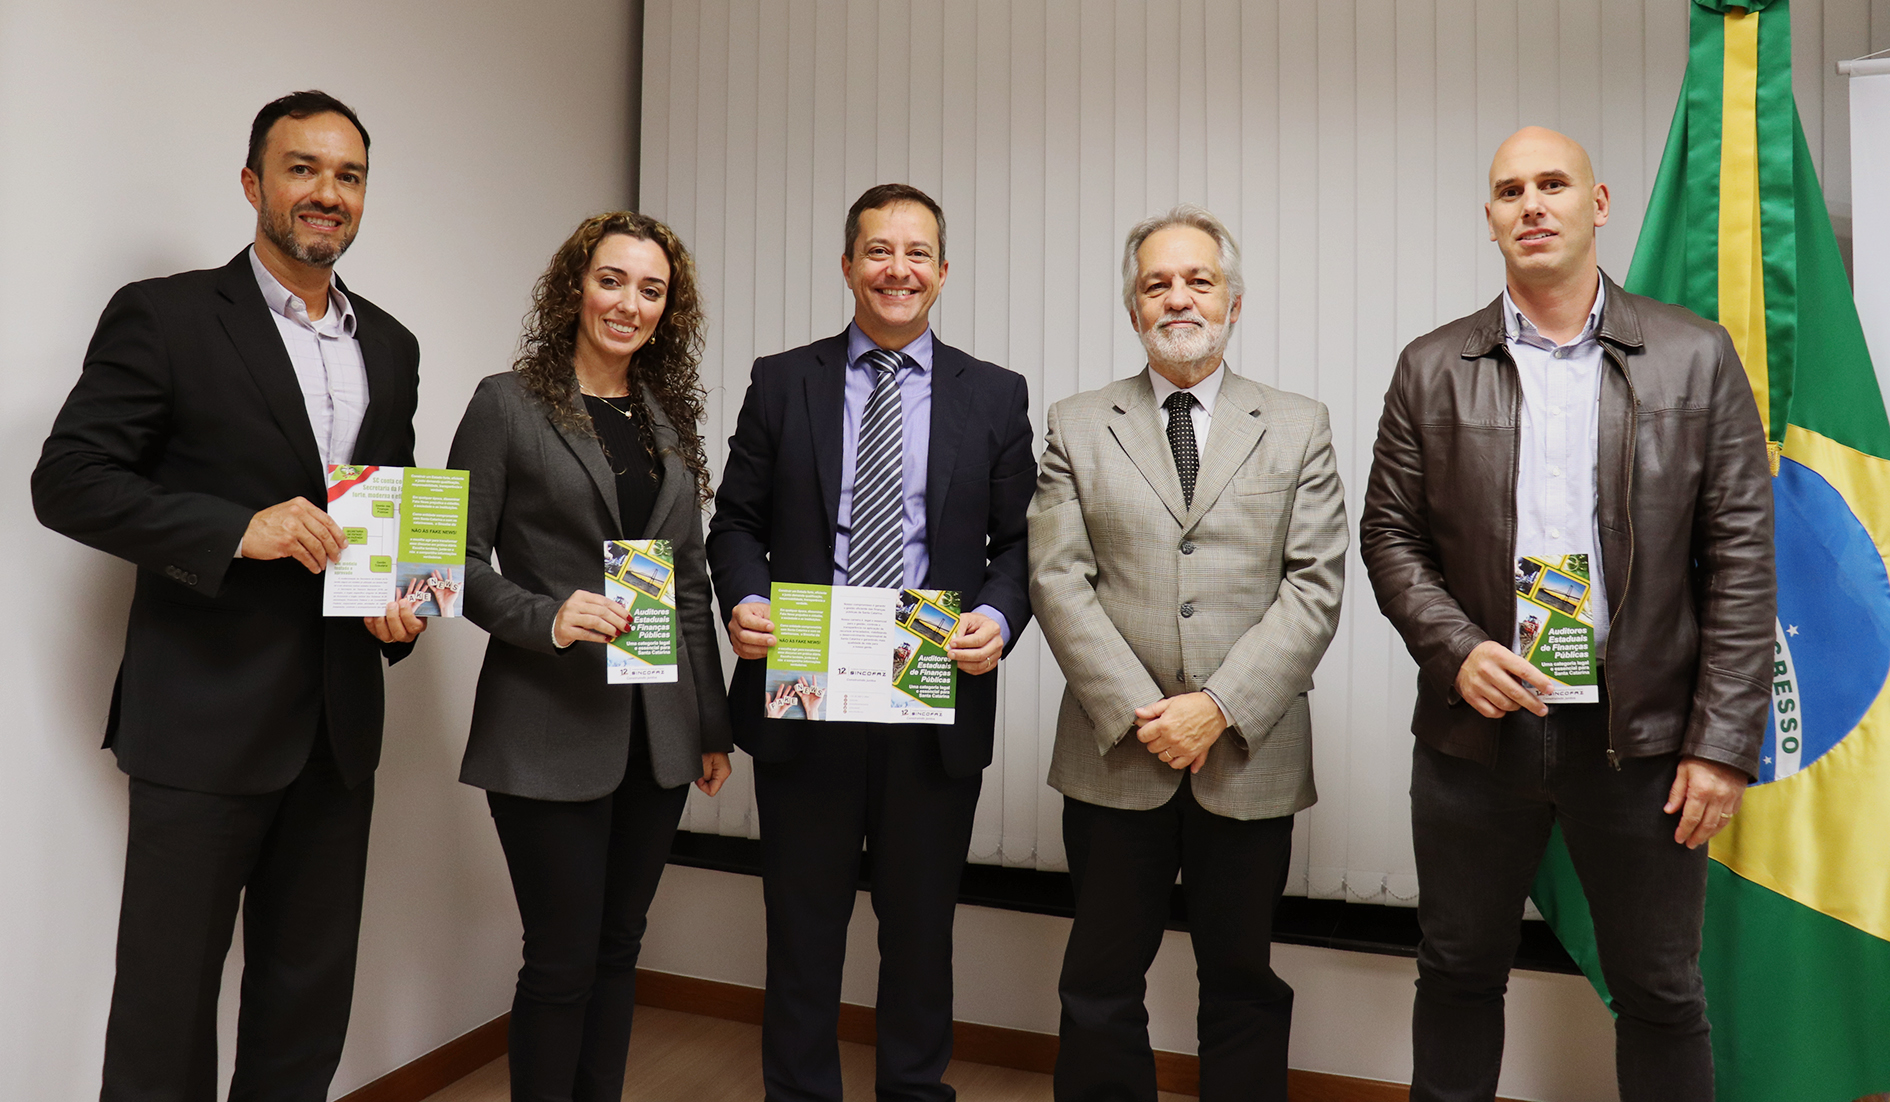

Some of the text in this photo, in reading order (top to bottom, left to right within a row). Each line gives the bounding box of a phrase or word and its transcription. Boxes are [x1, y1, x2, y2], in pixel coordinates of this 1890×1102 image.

[409, 578, 458, 601] AKE NEWS
[634, 608, 670, 616] Auditores
[637, 624, 670, 632] Finanças
[1548, 627, 1587, 636] Auditores
[638, 631, 671, 639] Públicas
[1548, 635, 1588, 643] Estaduais
[1540, 643, 1588, 652] de Finanças
[1554, 651, 1589, 659] Públicas
[838, 667, 847, 675] 12
[920, 669, 951, 677] Finanças
[797, 684, 823, 696] NEWS
